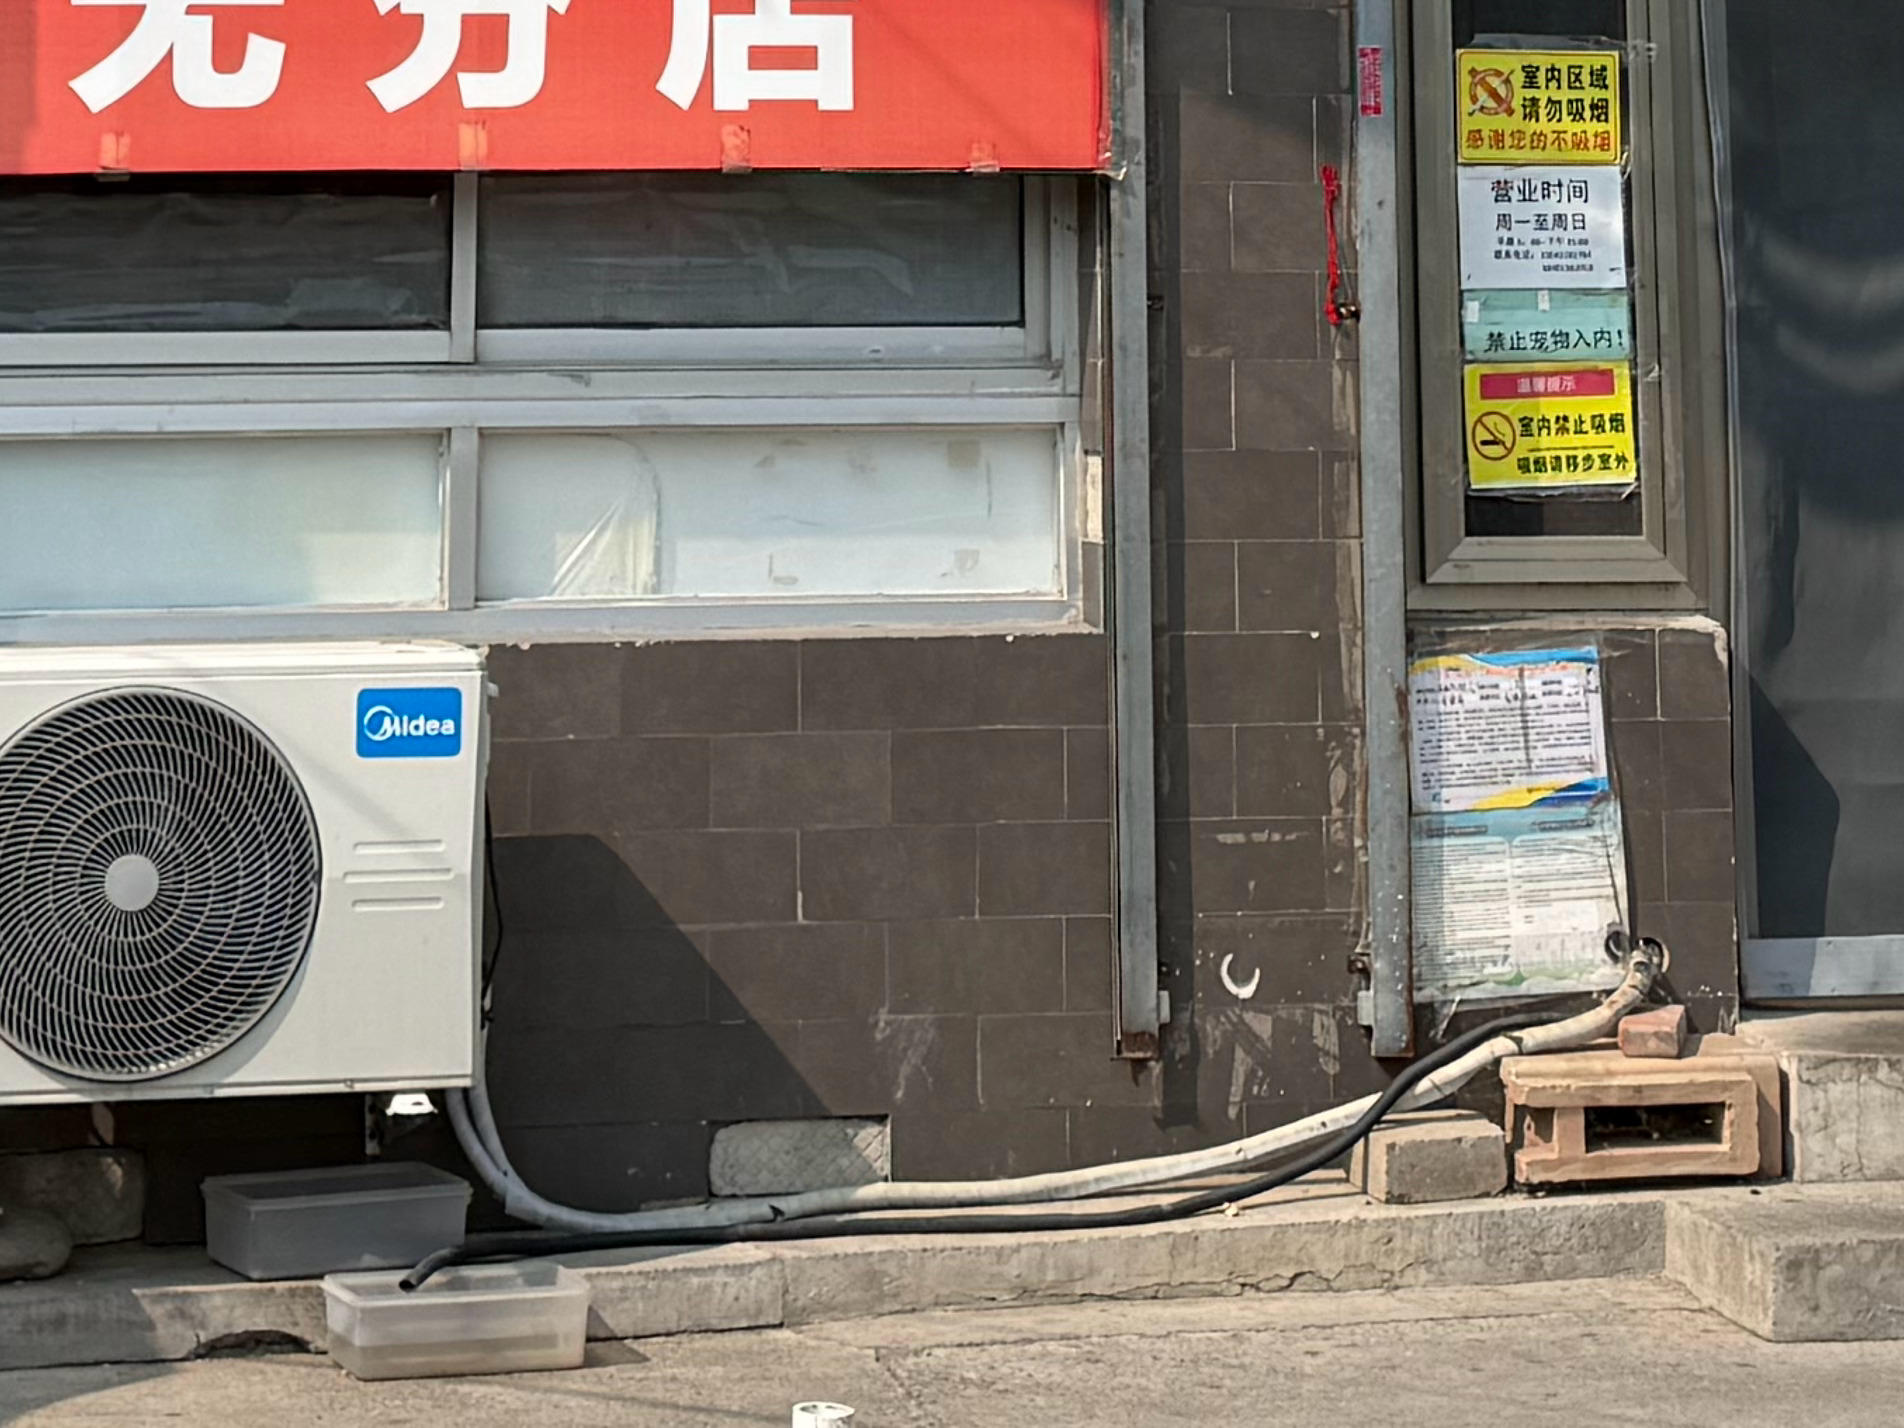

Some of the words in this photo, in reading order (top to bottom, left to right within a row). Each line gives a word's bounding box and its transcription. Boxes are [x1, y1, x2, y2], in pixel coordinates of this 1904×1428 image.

[1520, 63, 1610, 91] 室内区域
[1520, 95, 1610, 124] 请勿吸烟
[1465, 128, 1612, 153] 感谢您的不吸烟
[1490, 177, 1589, 204] 营业时间
[1495, 212, 1587, 232] 周一至周日
[1517, 412, 1626, 438] 室内禁止吸烟
[363, 704, 456, 742] Midea
